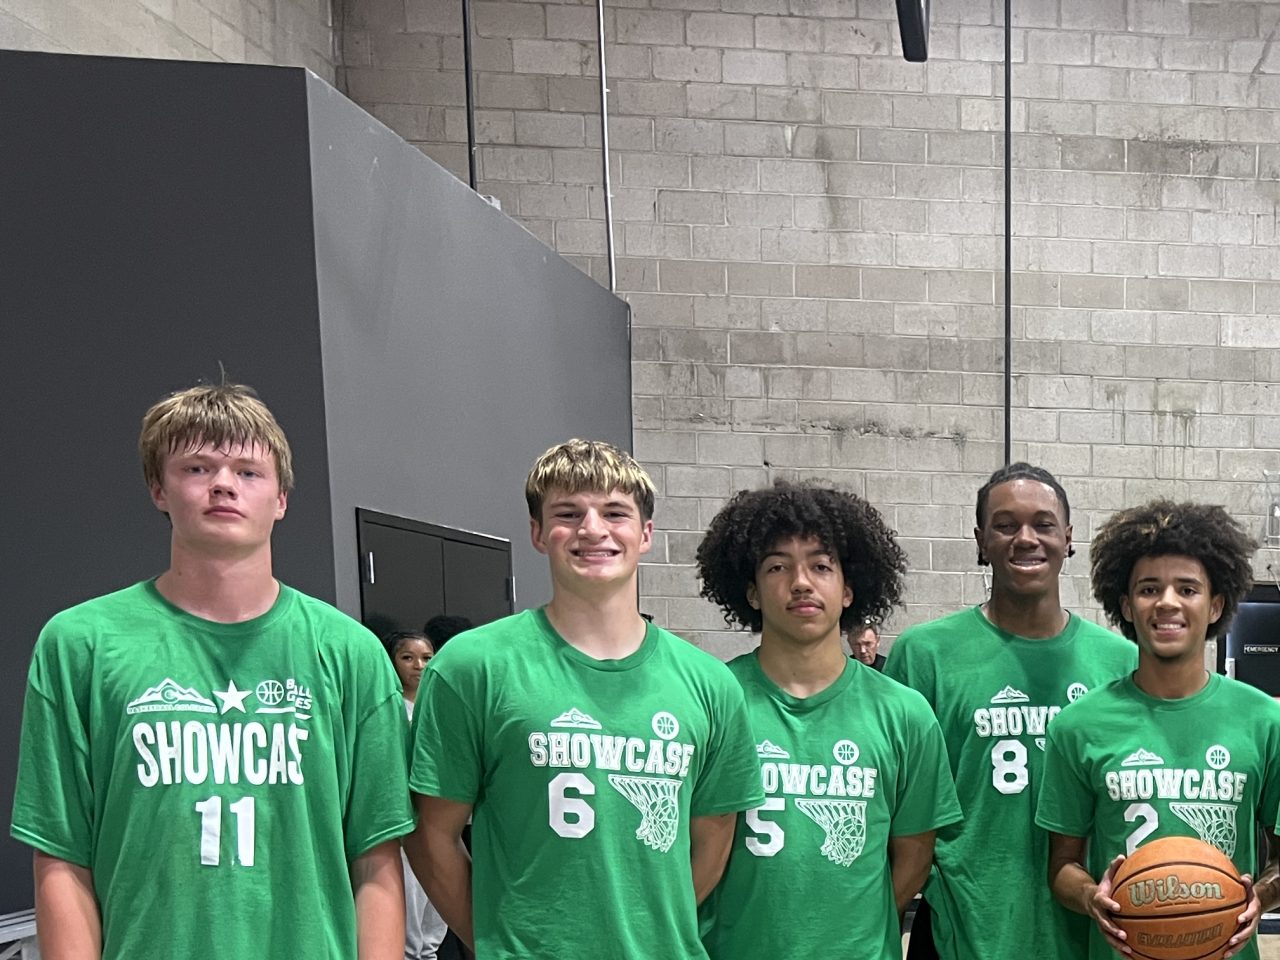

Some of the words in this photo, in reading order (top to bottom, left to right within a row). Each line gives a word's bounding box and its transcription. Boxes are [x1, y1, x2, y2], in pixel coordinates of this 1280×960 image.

[974, 706, 1062, 738] SHOW
[132, 720, 310, 788] SHOWCAS
[528, 732, 696, 778] SHOWCASE
[760, 762, 878, 798] OWCASE
[991, 739, 1029, 795] 8
[548, 772, 596, 839] 6
[1105, 768, 1248, 803] SHOWCASE
[195, 795, 255, 867] 11
[745, 797, 785, 857] 5
[1123, 803, 1159, 858] 2
[1127, 874, 1225, 907] Wilson
